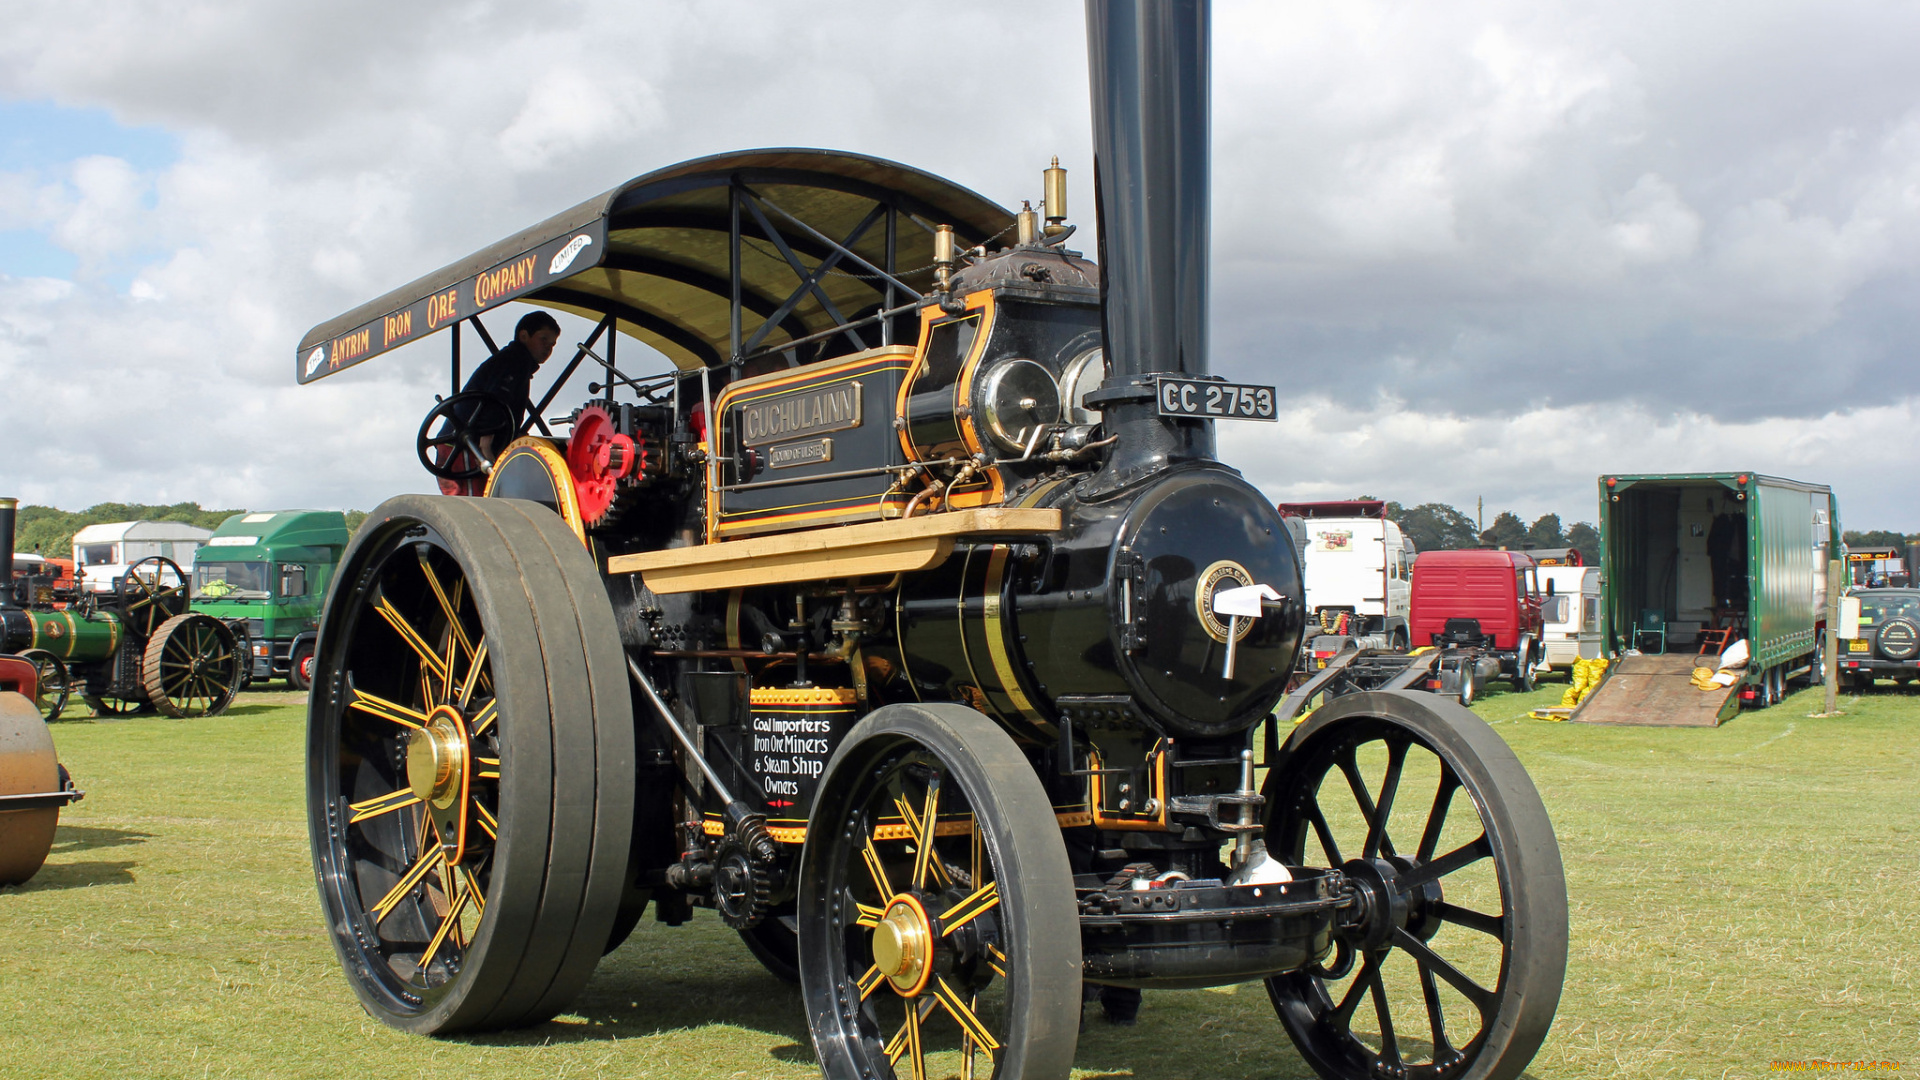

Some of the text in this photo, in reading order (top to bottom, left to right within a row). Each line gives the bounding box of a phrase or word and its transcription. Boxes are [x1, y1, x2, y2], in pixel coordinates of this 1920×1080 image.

[330, 329, 369, 370] ANTRIM
[383, 311, 411, 349] IRON
[427, 290, 457, 329] ORE
[475, 254, 537, 308] COMPANY
[554, 237, 583, 269] LIMITED
[1163, 382, 1273, 416] CC 2753
[747, 388, 852, 439] CUCHULAINN
[753, 718, 831, 735] Coal Importers
[754, 734, 829, 754] Iron Ore Miners
[754, 755, 823, 779] & Steam Ship
[764, 775, 799, 795] Owners
